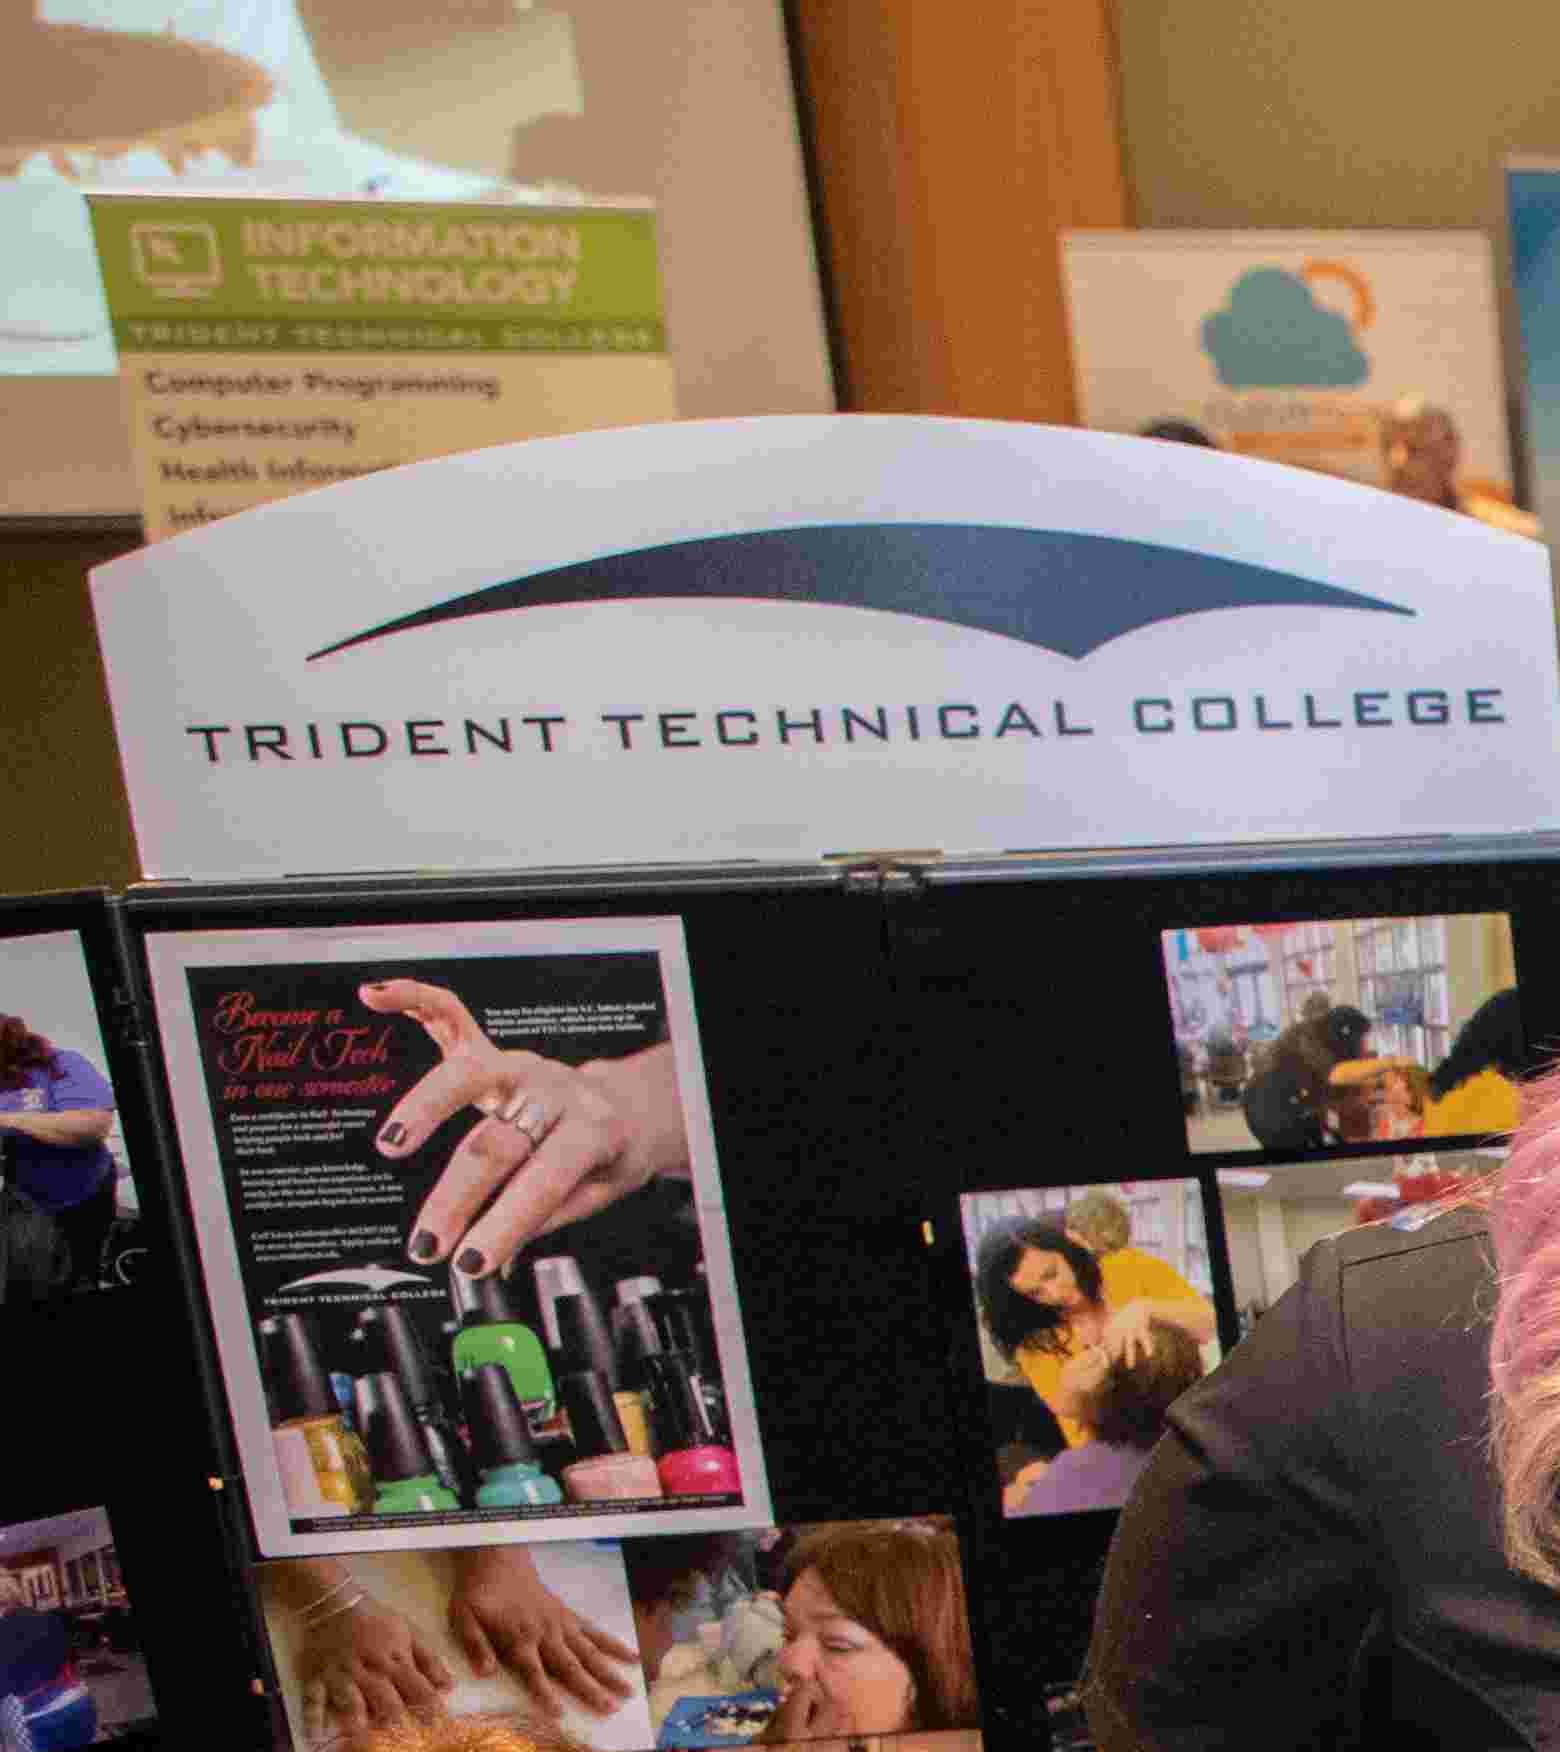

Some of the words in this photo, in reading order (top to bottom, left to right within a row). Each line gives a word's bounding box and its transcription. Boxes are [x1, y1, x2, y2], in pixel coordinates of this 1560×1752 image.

[240, 217, 580, 260] INFORMATION
[247, 262, 575, 305] TECHNOLOGY
[131, 323, 279, 346] TRIDENT
[144, 371, 293, 399] Computer
[303, 370, 500, 402] Programming
[153, 416, 357, 447] Cybersecurity
[160, 458, 257, 484] Health
[186, 715, 566, 763] TRIDENT
[601, 701, 1092, 749] TECHNICAL
[1133, 688, 1505, 733] COLLEGE
